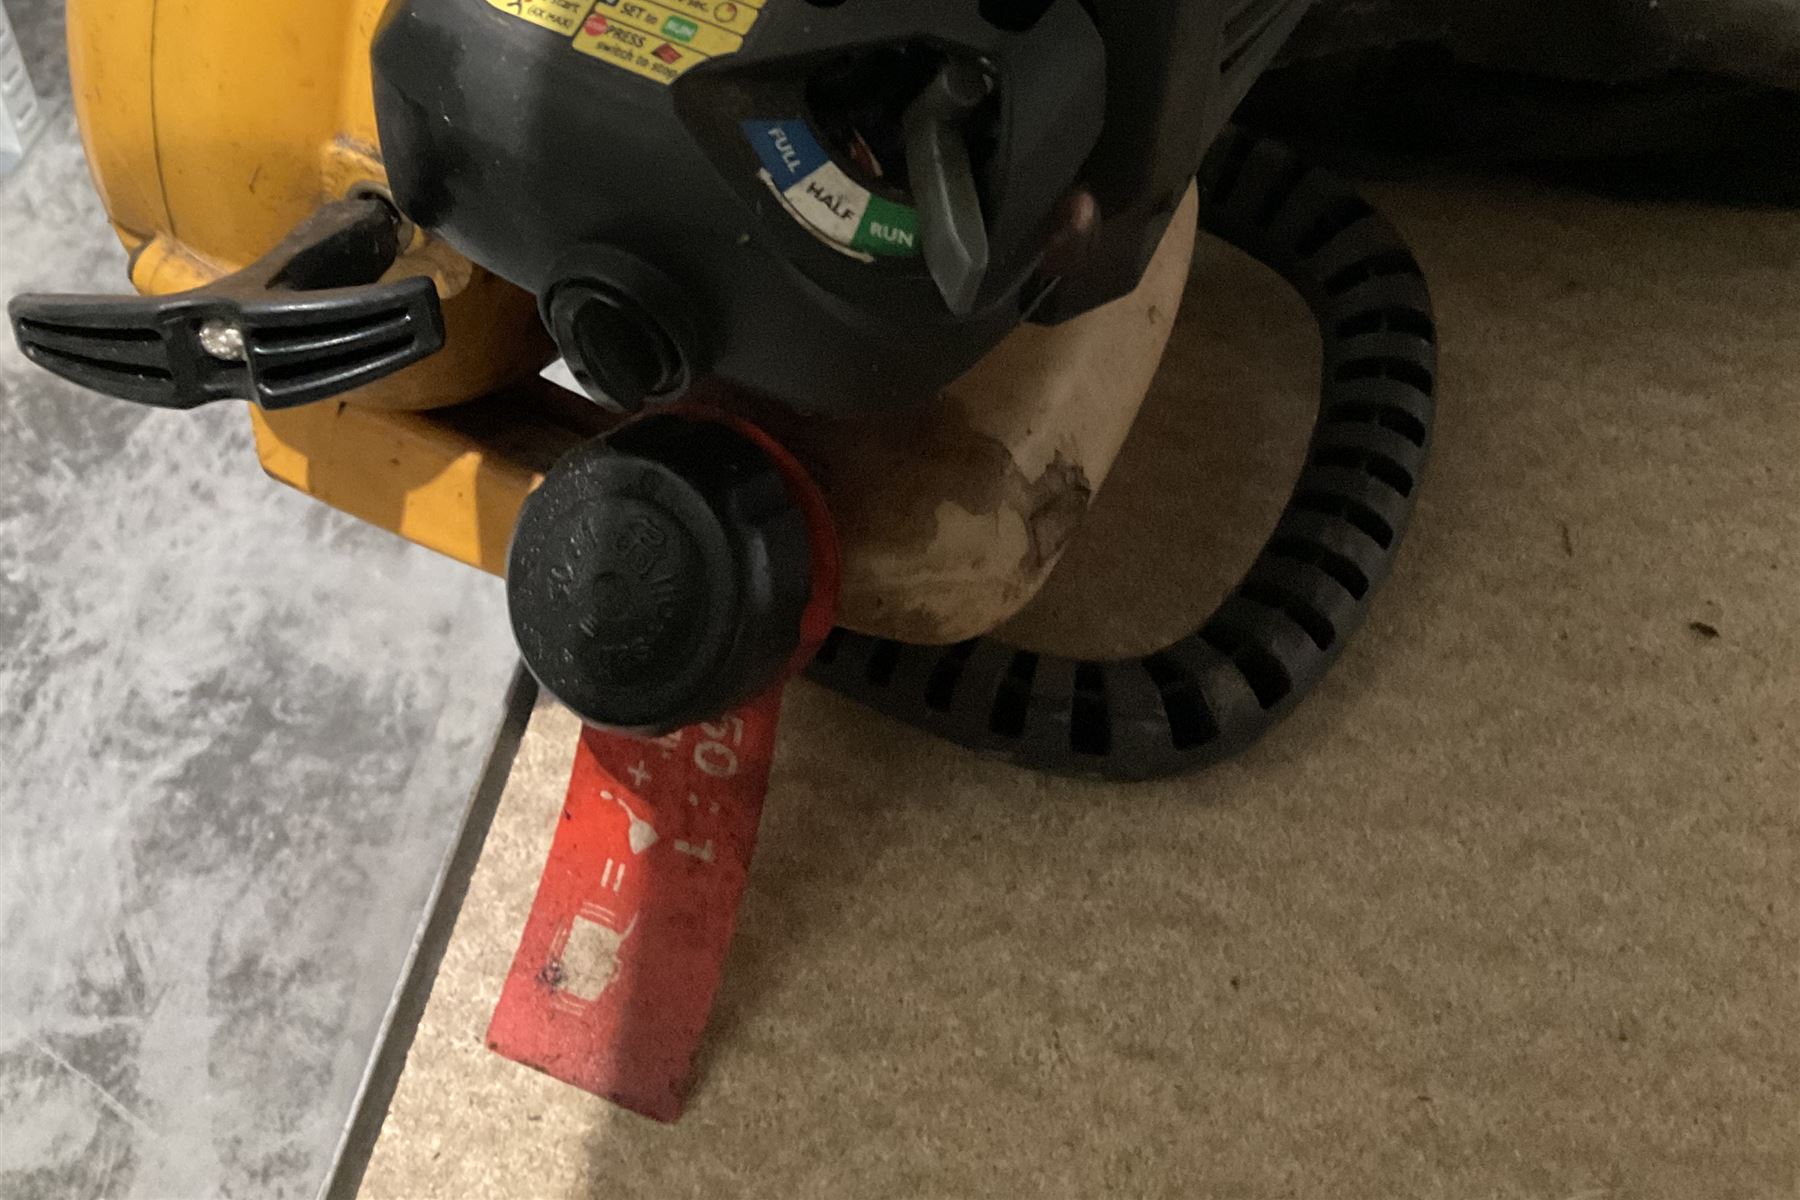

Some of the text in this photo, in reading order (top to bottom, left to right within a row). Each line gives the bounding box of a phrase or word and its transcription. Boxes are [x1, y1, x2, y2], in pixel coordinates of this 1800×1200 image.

[605, 24, 647, 48] PRESS
[620, 2, 696, 37] SET to RUN
[596, 41, 678, 79] switch to stop
[768, 126, 801, 174] FULL
[806, 181, 856, 222] HALF
[869, 221, 916, 248] RUN
